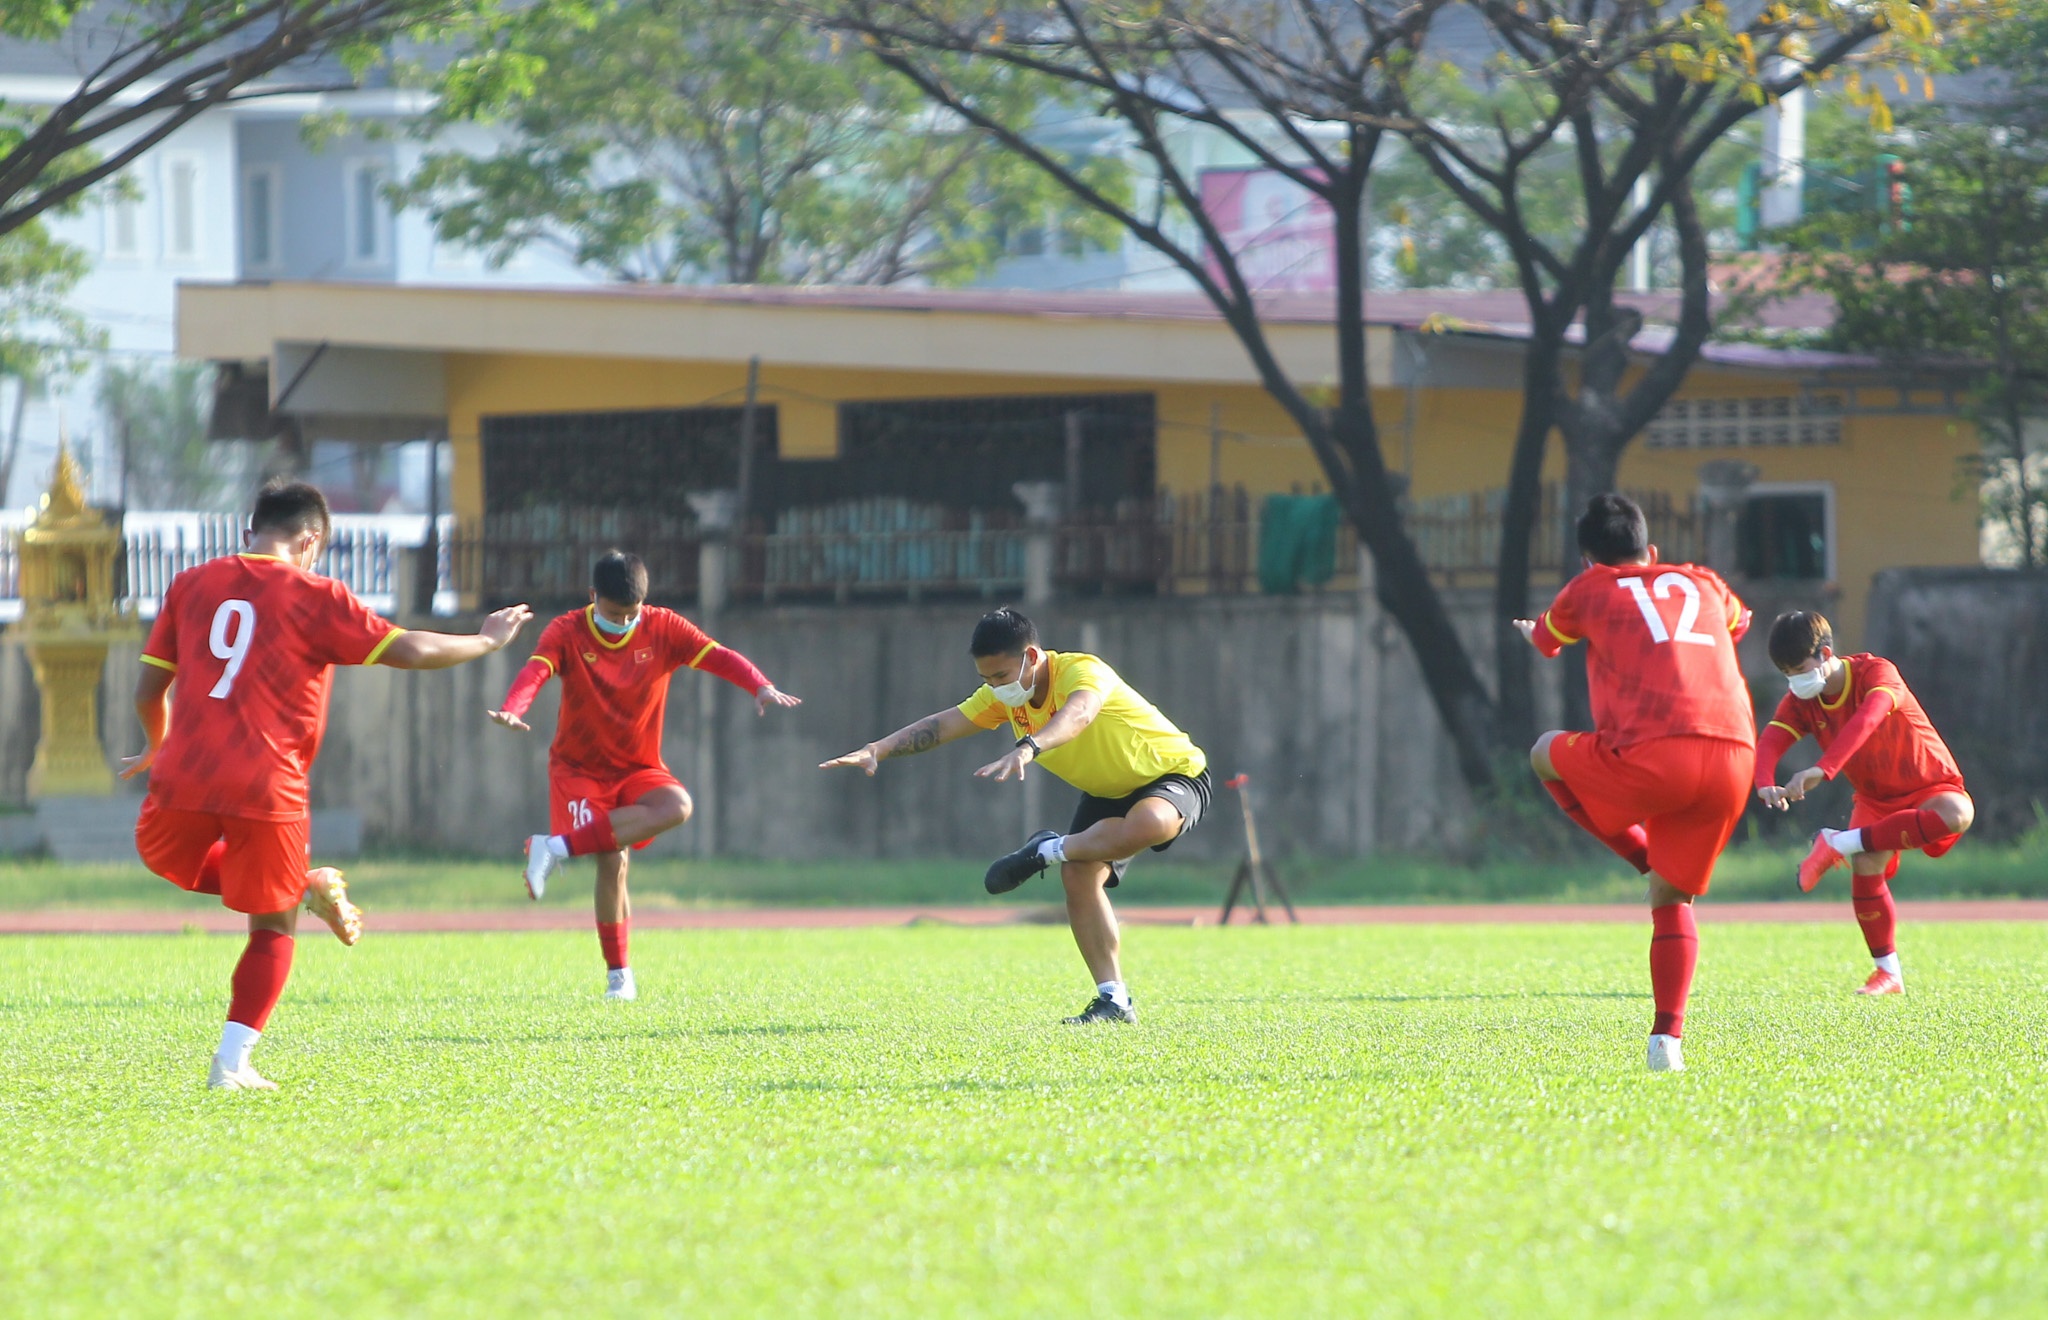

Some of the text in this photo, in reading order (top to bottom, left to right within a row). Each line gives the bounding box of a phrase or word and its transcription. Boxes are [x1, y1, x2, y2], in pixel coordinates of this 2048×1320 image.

[1616, 572, 1716, 645] 12
[208, 599, 255, 699] 9
[567, 797, 593, 830] 26
